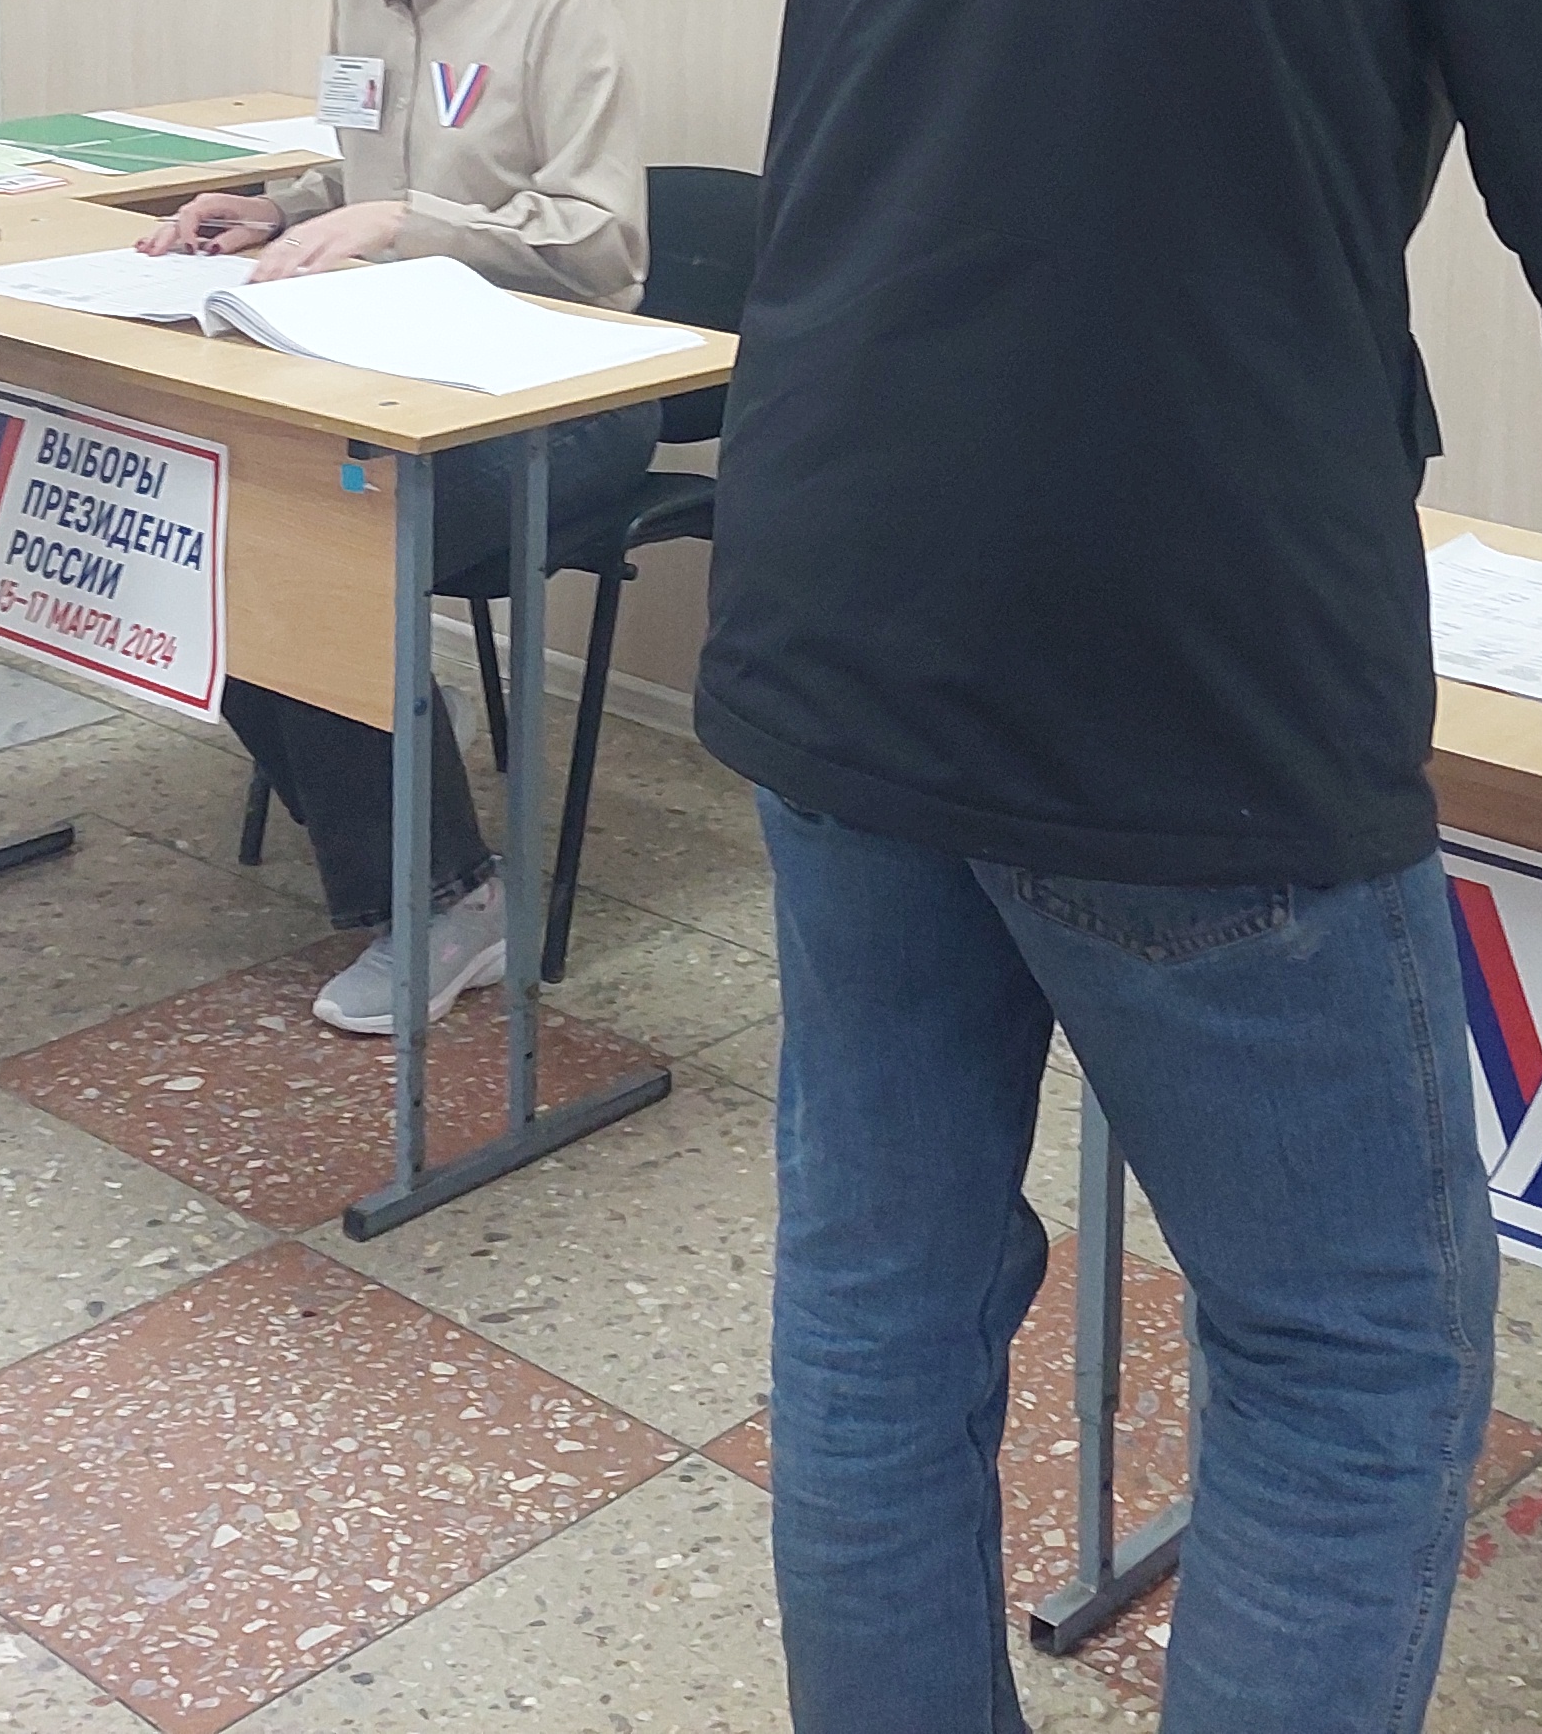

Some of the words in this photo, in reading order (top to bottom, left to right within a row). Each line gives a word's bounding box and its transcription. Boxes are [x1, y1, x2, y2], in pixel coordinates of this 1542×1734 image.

[35, 427, 169, 499] ВЫБОРЫ
[21, 479, 206, 571] ПРЕЗИДЕНТА
[5, 529, 125, 600] РОССИИ
[46, 600, 121, 653] МАРТА
[120, 623, 179, 670] 2024
